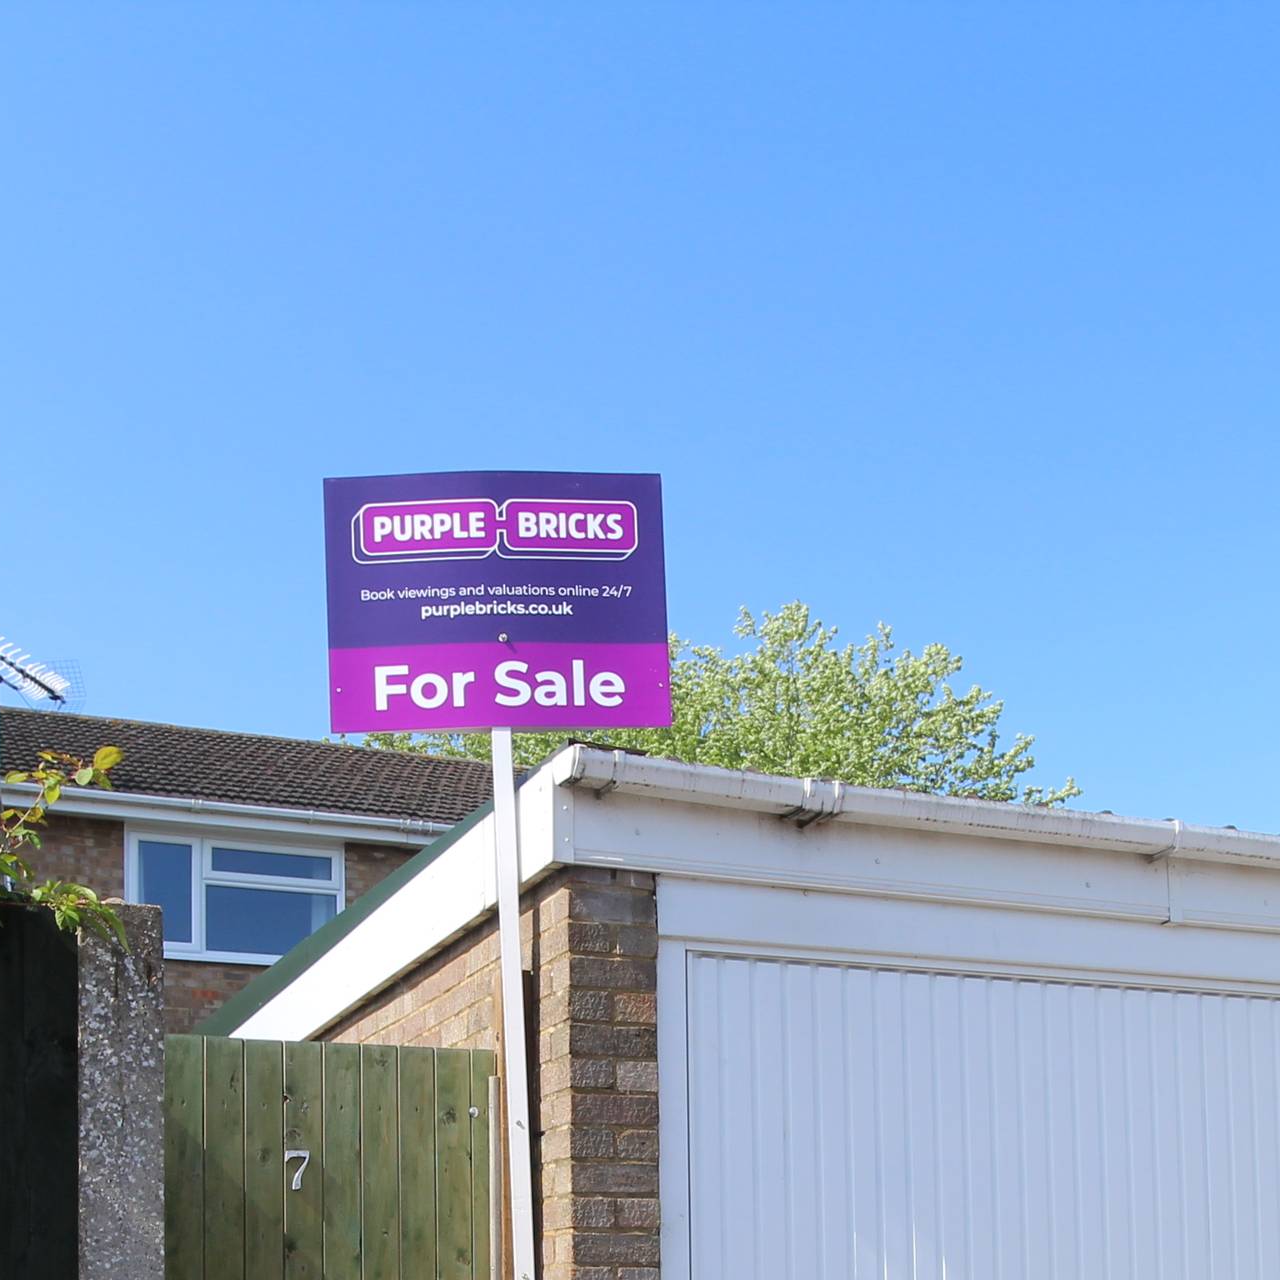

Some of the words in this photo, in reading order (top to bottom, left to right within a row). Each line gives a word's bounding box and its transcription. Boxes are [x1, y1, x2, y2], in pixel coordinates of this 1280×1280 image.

[373, 511, 486, 543] PURPLE
[518, 511, 624, 540] BRICKS
[360, 588, 396, 601] Book
[397, 586, 456, 600] viewings
[458, 584, 486, 597] and
[487, 583, 556, 597] valuations
[557, 584, 600, 598] online
[601, 584, 633, 598] 24/7
[421, 600, 574, 620] purplebricks.co.uk
[373, 664, 475, 711] For
[493, 658, 626, 707] Sale
[284, 1150, 310, 1190] 7
